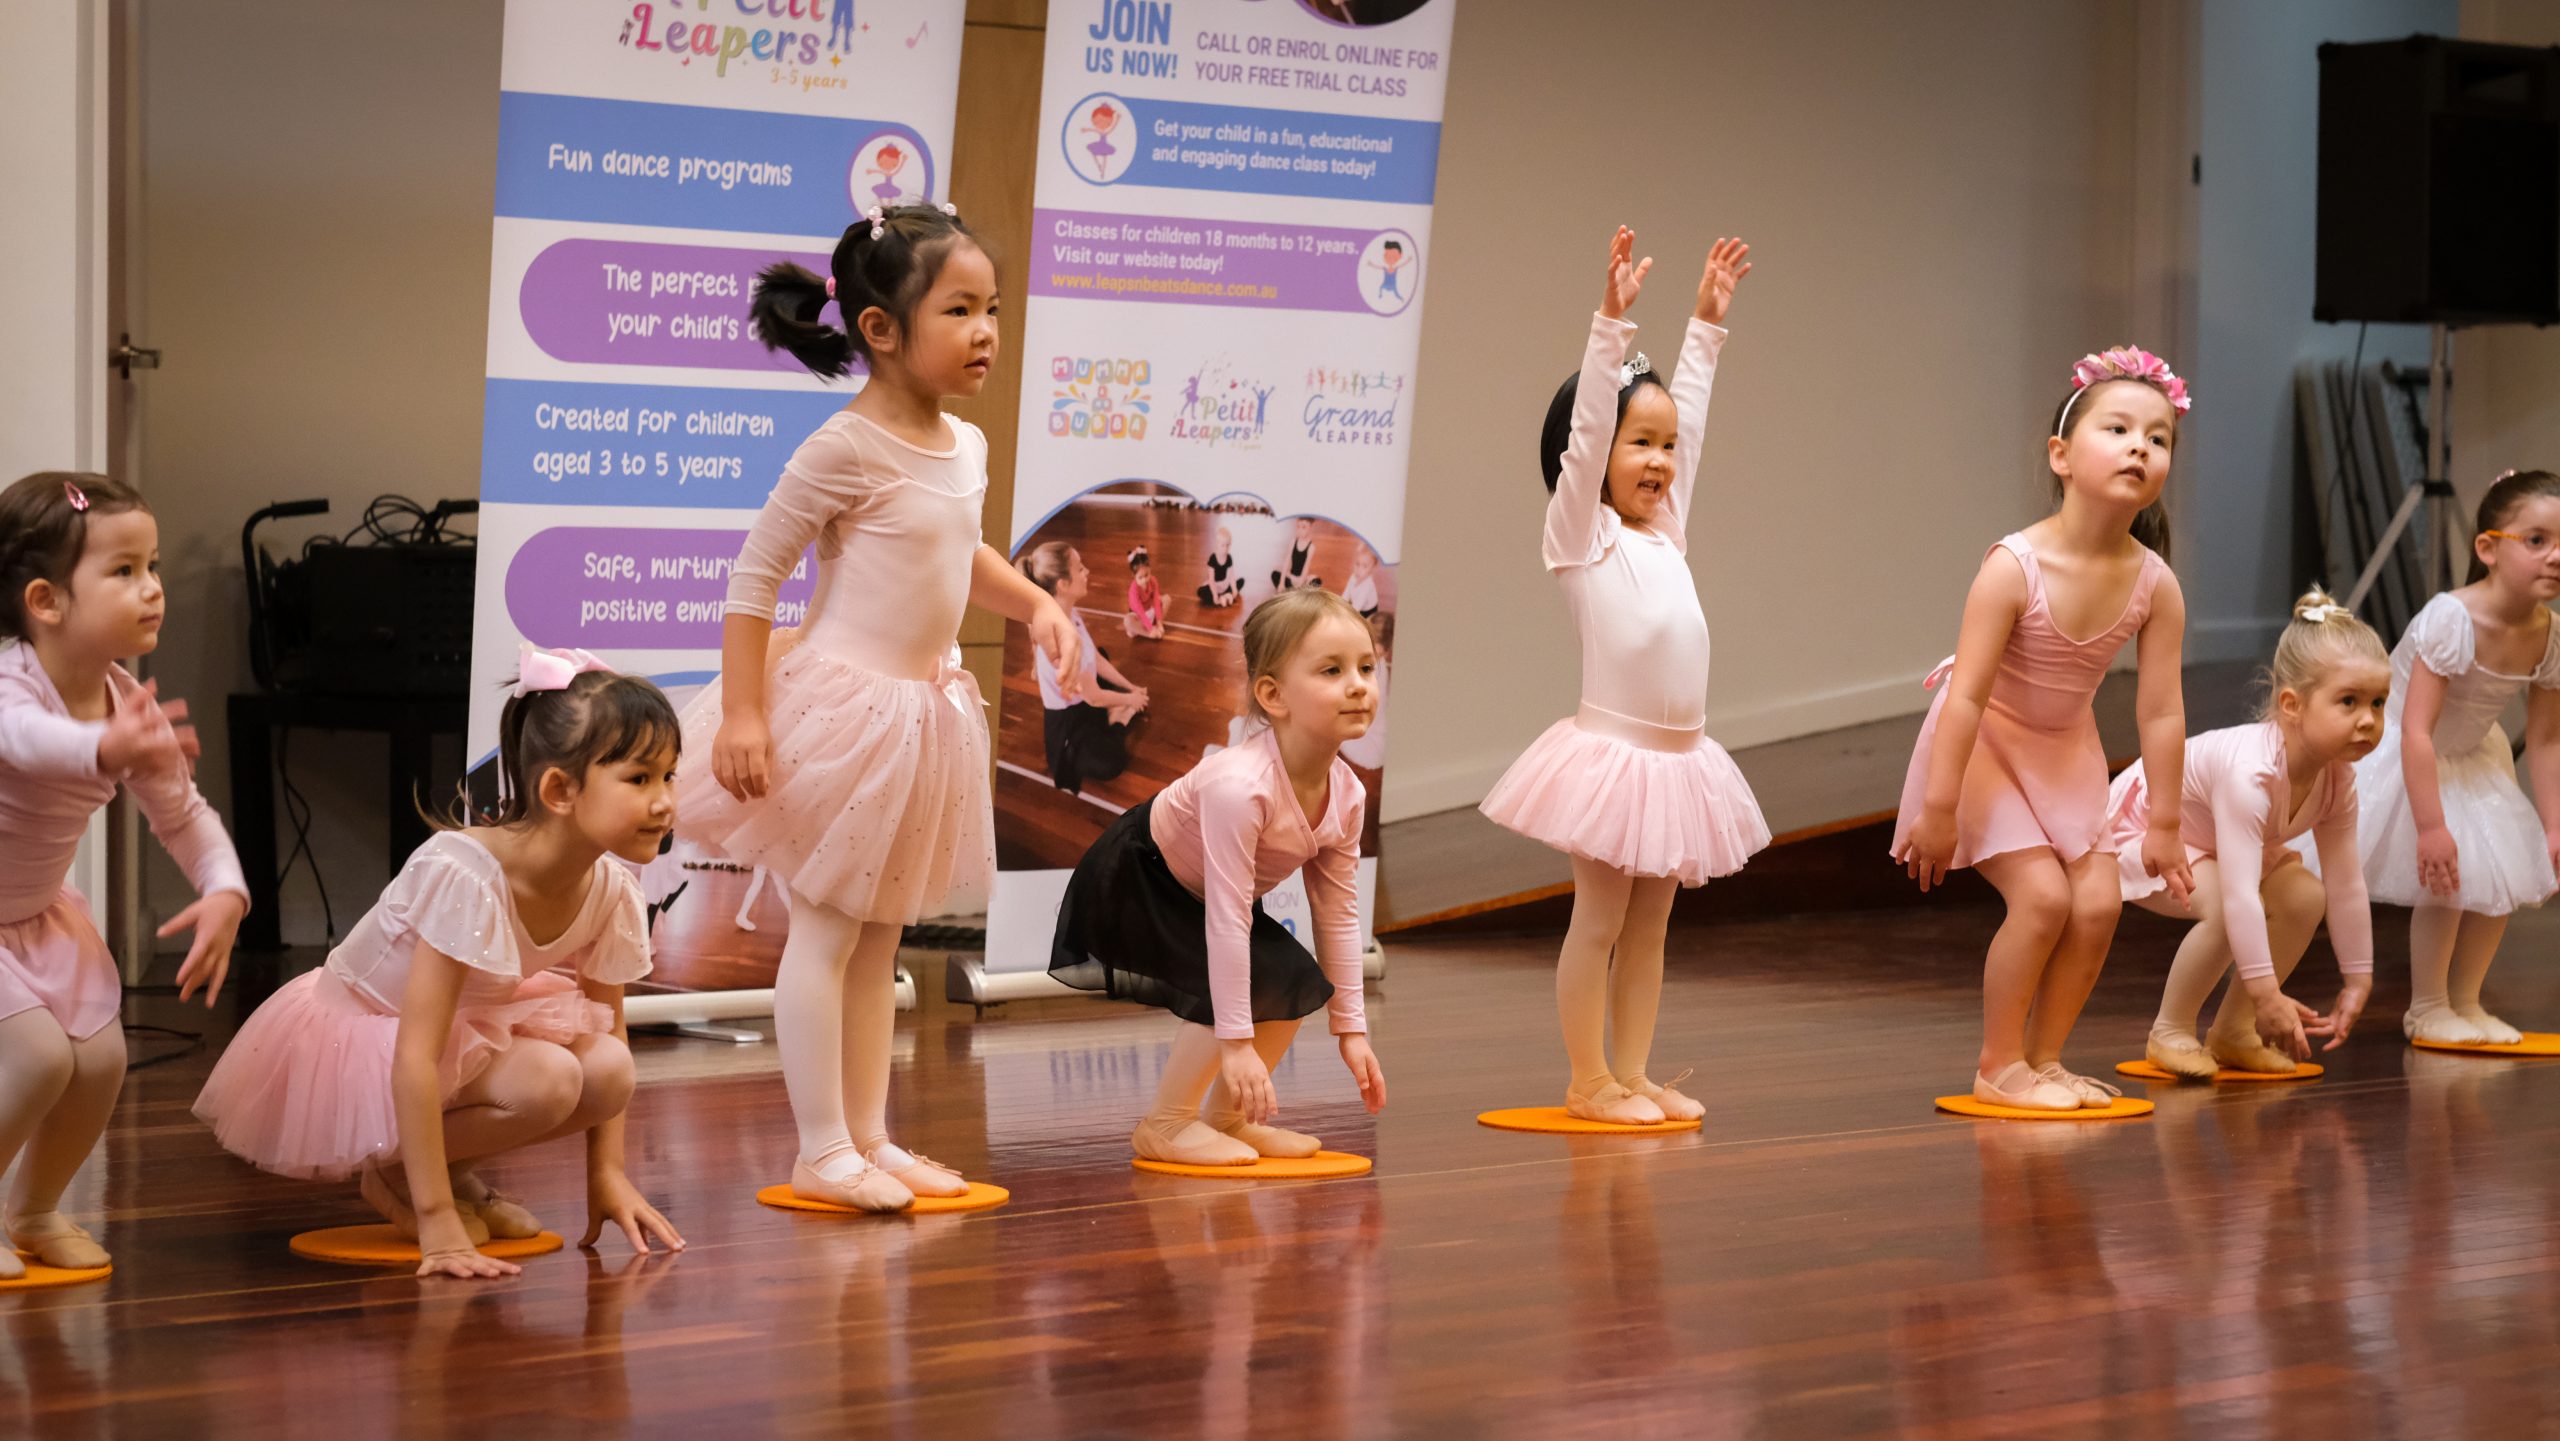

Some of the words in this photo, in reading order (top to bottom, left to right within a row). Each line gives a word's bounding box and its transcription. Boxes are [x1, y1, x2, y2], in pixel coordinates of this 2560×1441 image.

[1089, 0, 1172, 45] JOIN
[632, 3, 821, 78] Leapers
[1196, 31, 1242, 54] CALL
[1247, 36, 1272, 57] OR
[1276, 39, 1331, 63] ENROL
[1335, 44, 1403, 68] ONLINE
[1407, 50, 1440, 71] FOR
[770, 67, 798, 86] 3-5
[802, 73, 848, 92] years
[1085, 47, 1114, 74] US
[1121, 50, 1178, 79] NOW!
[1194, 61, 1243, 84] YOUR
[1248, 66, 1291, 88] FREE
[1293, 70, 1342, 93] TRIAL
[1347, 74, 1407, 97] CLASS
[1154, 119, 1179, 137] Get
[1181, 123, 1212, 141] your
[1215, 123, 1251, 142] child
[1254, 127, 1267, 143] in
[1270, 132, 1279, 145] a
[1281, 129, 1306, 149] fun,
[1309, 132, 1393, 153] educational
[548, 143, 593, 173] Fun
[602, 149, 671, 178] dance
[678, 156, 793, 191] programs
[1152, 146, 1179, 162] and
[1181, 149, 1247, 171] engaging
[1250, 152, 1291, 170] dance
[1293, 156, 1329, 173] class
[1331, 158, 1377, 180] today!
[1055, 220, 1118, 239] Classes
[1121, 224, 1142, 241] for
[1145, 227, 1200, 245] children
[1205, 231, 1223, 246] 18
[1226, 234, 1278, 250] months
[1280, 237, 1294, 250] to
[1298, 236, 1314, 253] 12
[1316, 239, 1359, 257] years.
[1052, 245, 1091, 264] Visit
[1095, 251, 1120, 266] our
[1123, 252, 1177, 269] website
[1180, 254, 1224, 275] today!
[603, 264, 642, 292] The
[650, 270, 738, 299] perfect
[1051, 272, 1278, 299] www.leapsnbeatsdance.com.au
[608, 312, 662, 343] your
[670, 313, 739, 341] child's
[535, 403, 629, 432] Created
[637, 408, 677, 436] for
[685, 411, 774, 437] children
[1200, 396, 1255, 421] Petit
[1303, 394, 1398, 438] Grand
[1175, 419, 1252, 449] Leapers
[1316, 430, 1394, 446] LEAPERS
[533, 451, 591, 482] aged
[599, 450, 612, 476] 3
[621, 452, 646, 475] to
[654, 452, 669, 477] 5
[678, 455, 743, 485] years
[583, 552, 642, 584] Safe,
[651, 556, 737, 580] nurturi
[580, 599, 667, 628] positive
